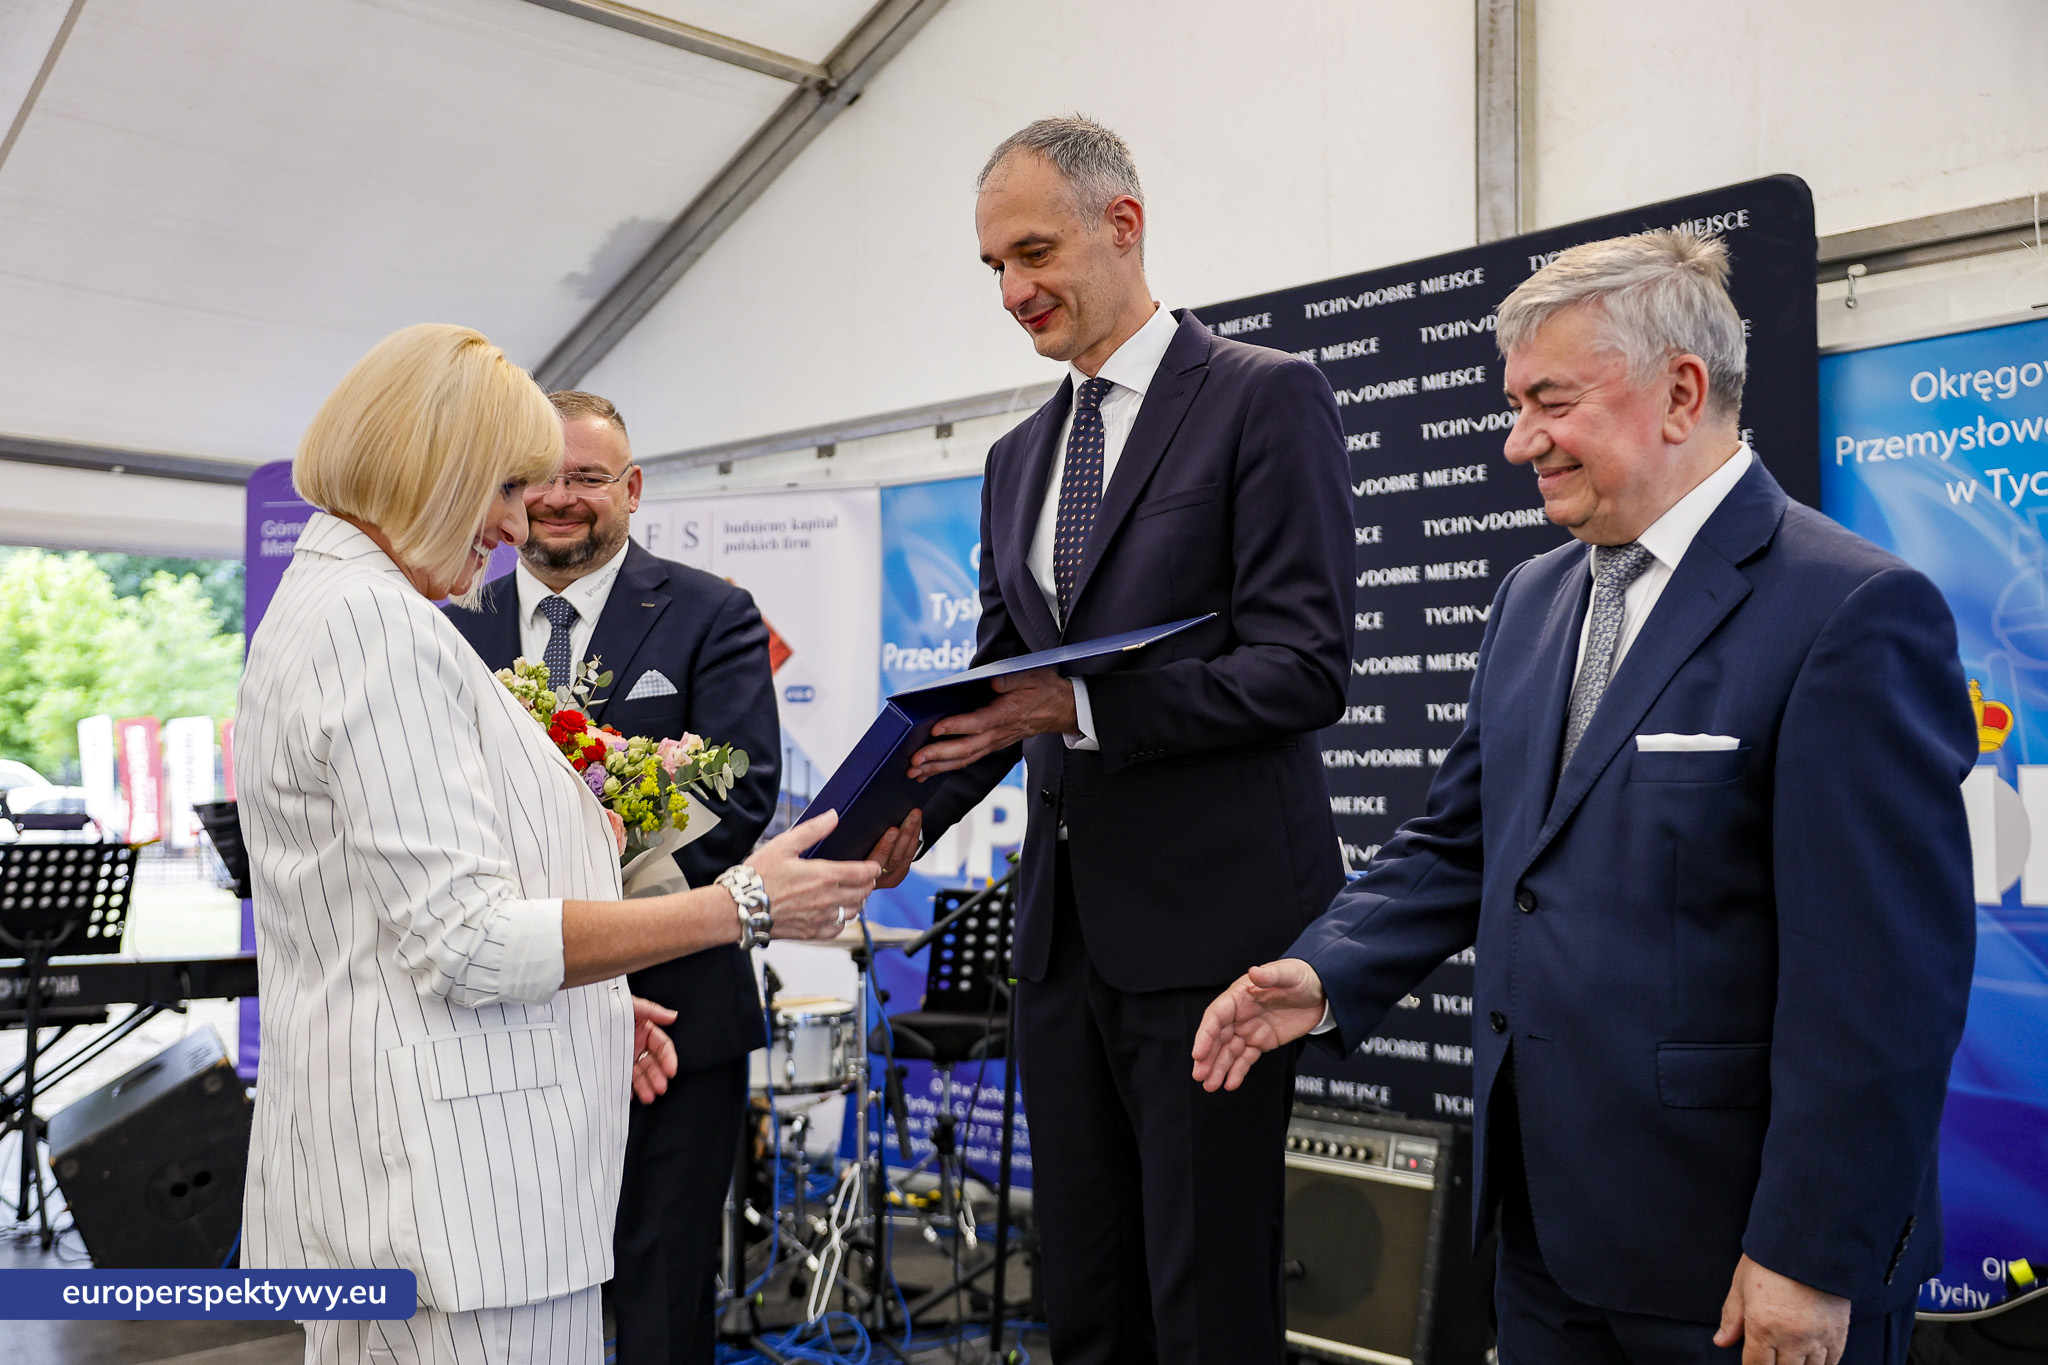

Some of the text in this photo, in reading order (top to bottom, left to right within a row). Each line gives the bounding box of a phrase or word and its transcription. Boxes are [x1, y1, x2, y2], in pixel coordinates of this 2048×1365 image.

[1420, 267, 1486, 296] MIEJSCE
[1218, 312, 1272, 336] MIEJSCE
[1320, 337, 1380, 362] MIEJSCE
[1421, 366, 1487, 391] MIEJSCE
[1910, 360, 2048, 403] Okręgo
[1835, 415, 2048, 466] Przemysłow
[1422, 464, 1488, 488] MIEJSCE
[1945, 478, 1978, 505] w
[783, 533, 811, 549] firm
[1424, 559, 1490, 582] MIEJSCE
[1338, 704, 1386, 724] EJSCE
[1321, 749, 1357, 768] CHY
[1330, 796, 1387, 815] MIEJSCE
[1329, 1078, 1391, 1106] MIEJSCE
[1928, 1278, 1990, 1310] Tychy
